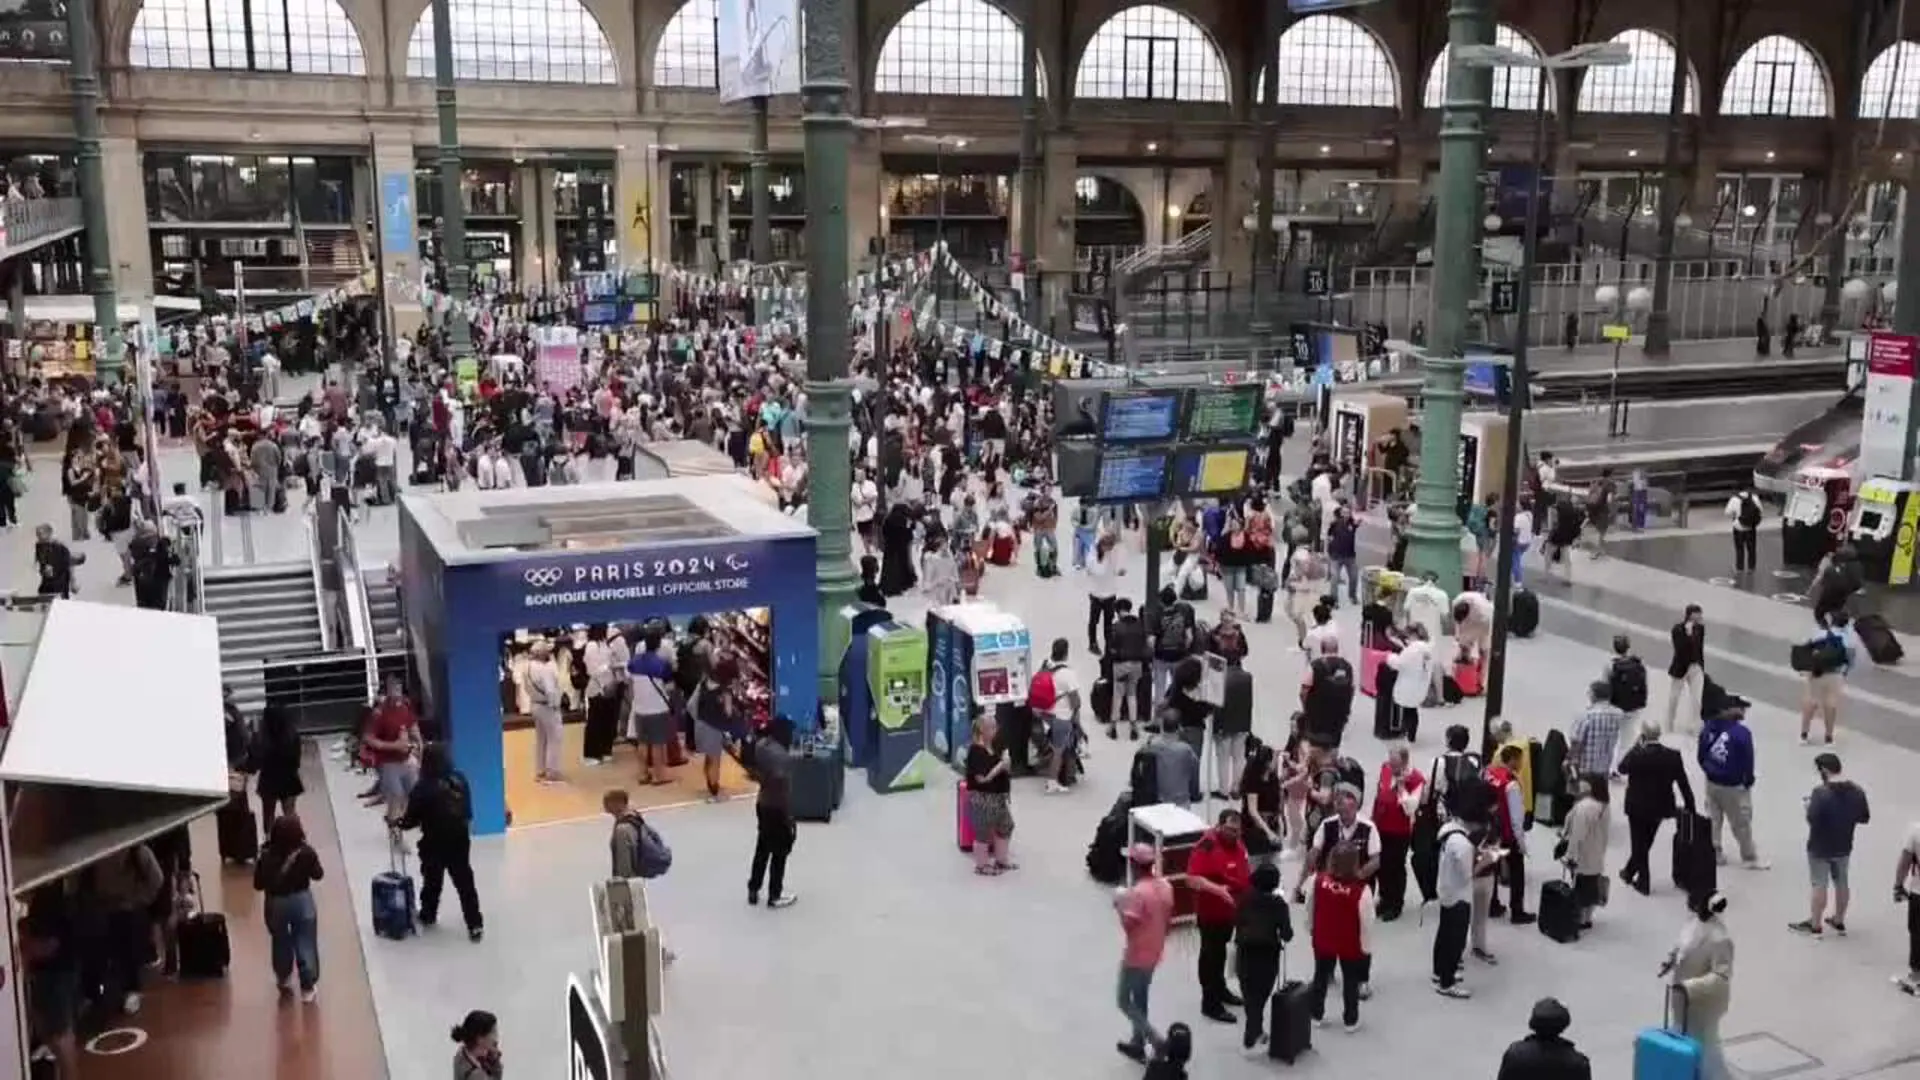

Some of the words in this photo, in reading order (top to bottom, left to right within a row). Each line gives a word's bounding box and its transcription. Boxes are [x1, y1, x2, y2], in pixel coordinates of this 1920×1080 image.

[575, 560, 645, 584] PARIS
[653, 554, 715, 577] 2024
[525, 590, 588, 606] BOUTIQUE
[590, 584, 655, 600] OFFICIELLE
[662, 580, 712, 595] OFFICIAL
[714, 577, 749, 591] STORE
